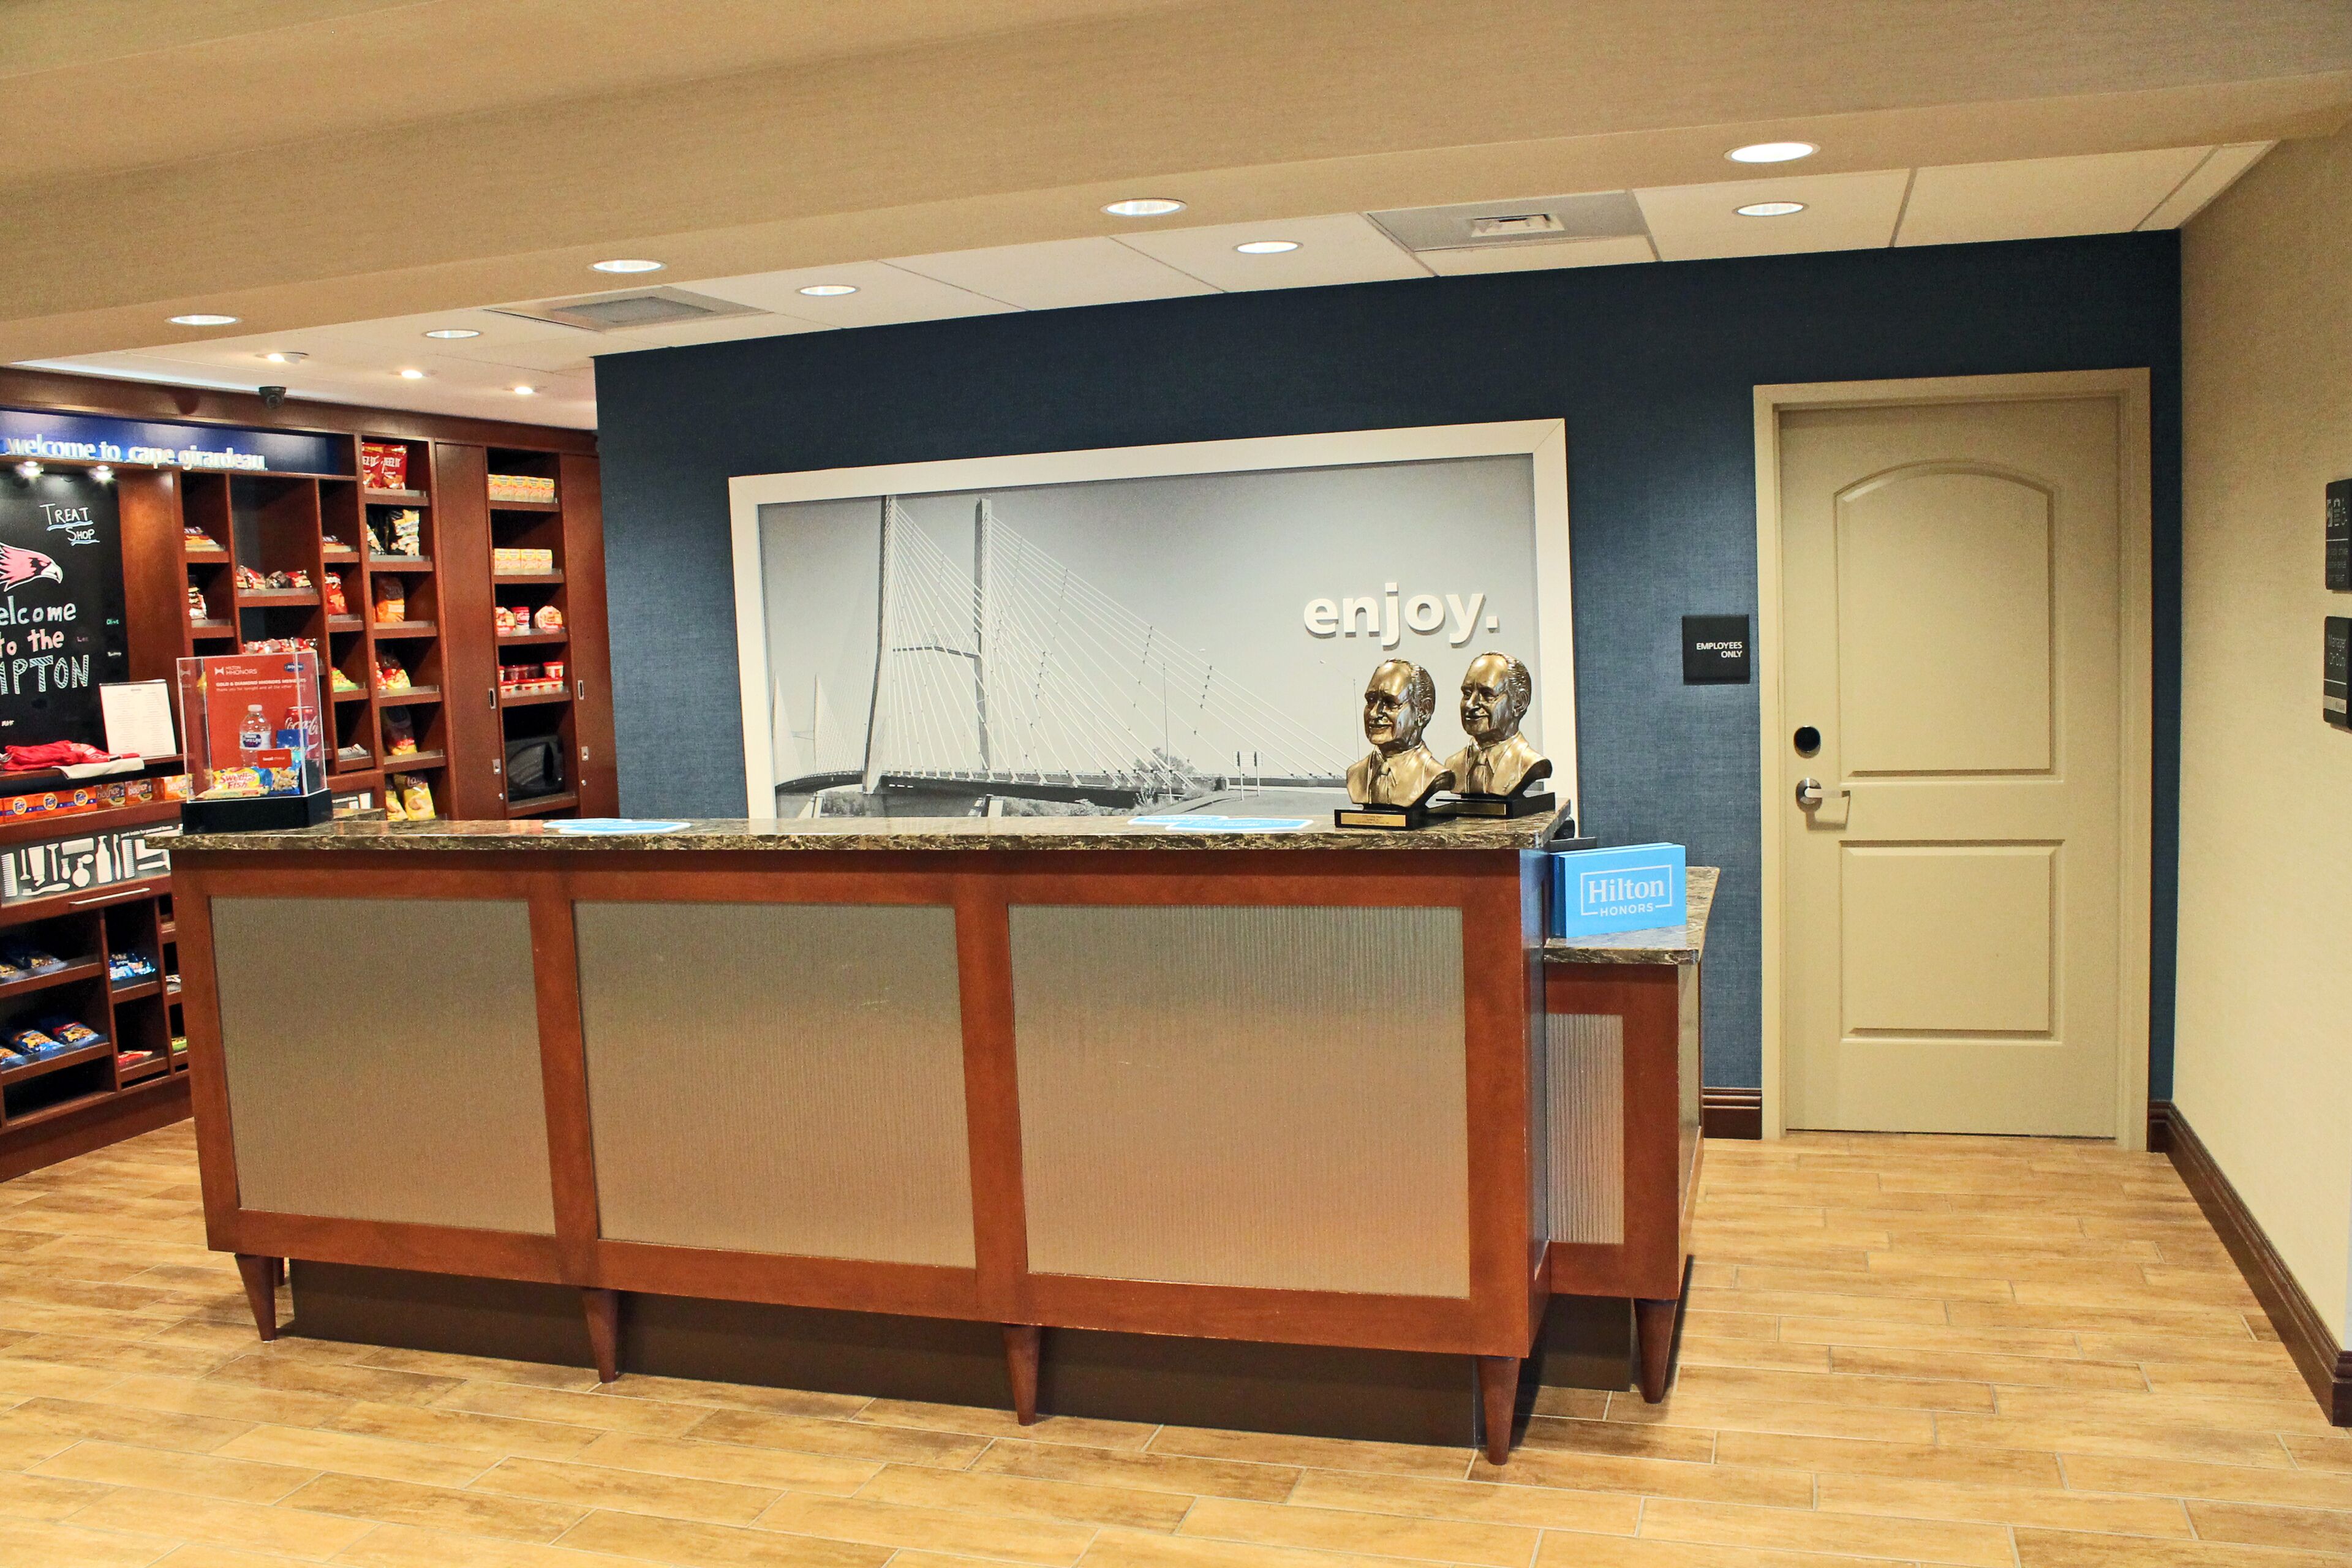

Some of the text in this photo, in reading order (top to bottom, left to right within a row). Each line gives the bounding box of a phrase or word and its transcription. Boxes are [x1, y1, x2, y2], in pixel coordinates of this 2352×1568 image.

[6, 434, 266, 470] welcome to cape girardeau
[39, 503, 89, 525] TREAT
[66, 527, 95, 541] SHOP
[0, 595, 77, 626] elcome
[1304, 582, 1499, 649] enjoy.
[27, 628, 65, 652] the
[1696, 642, 1743, 650] EMPLOYEES
[1588, 877, 1665, 904] Hilton
[1600, 903, 1654, 917] HONORS
